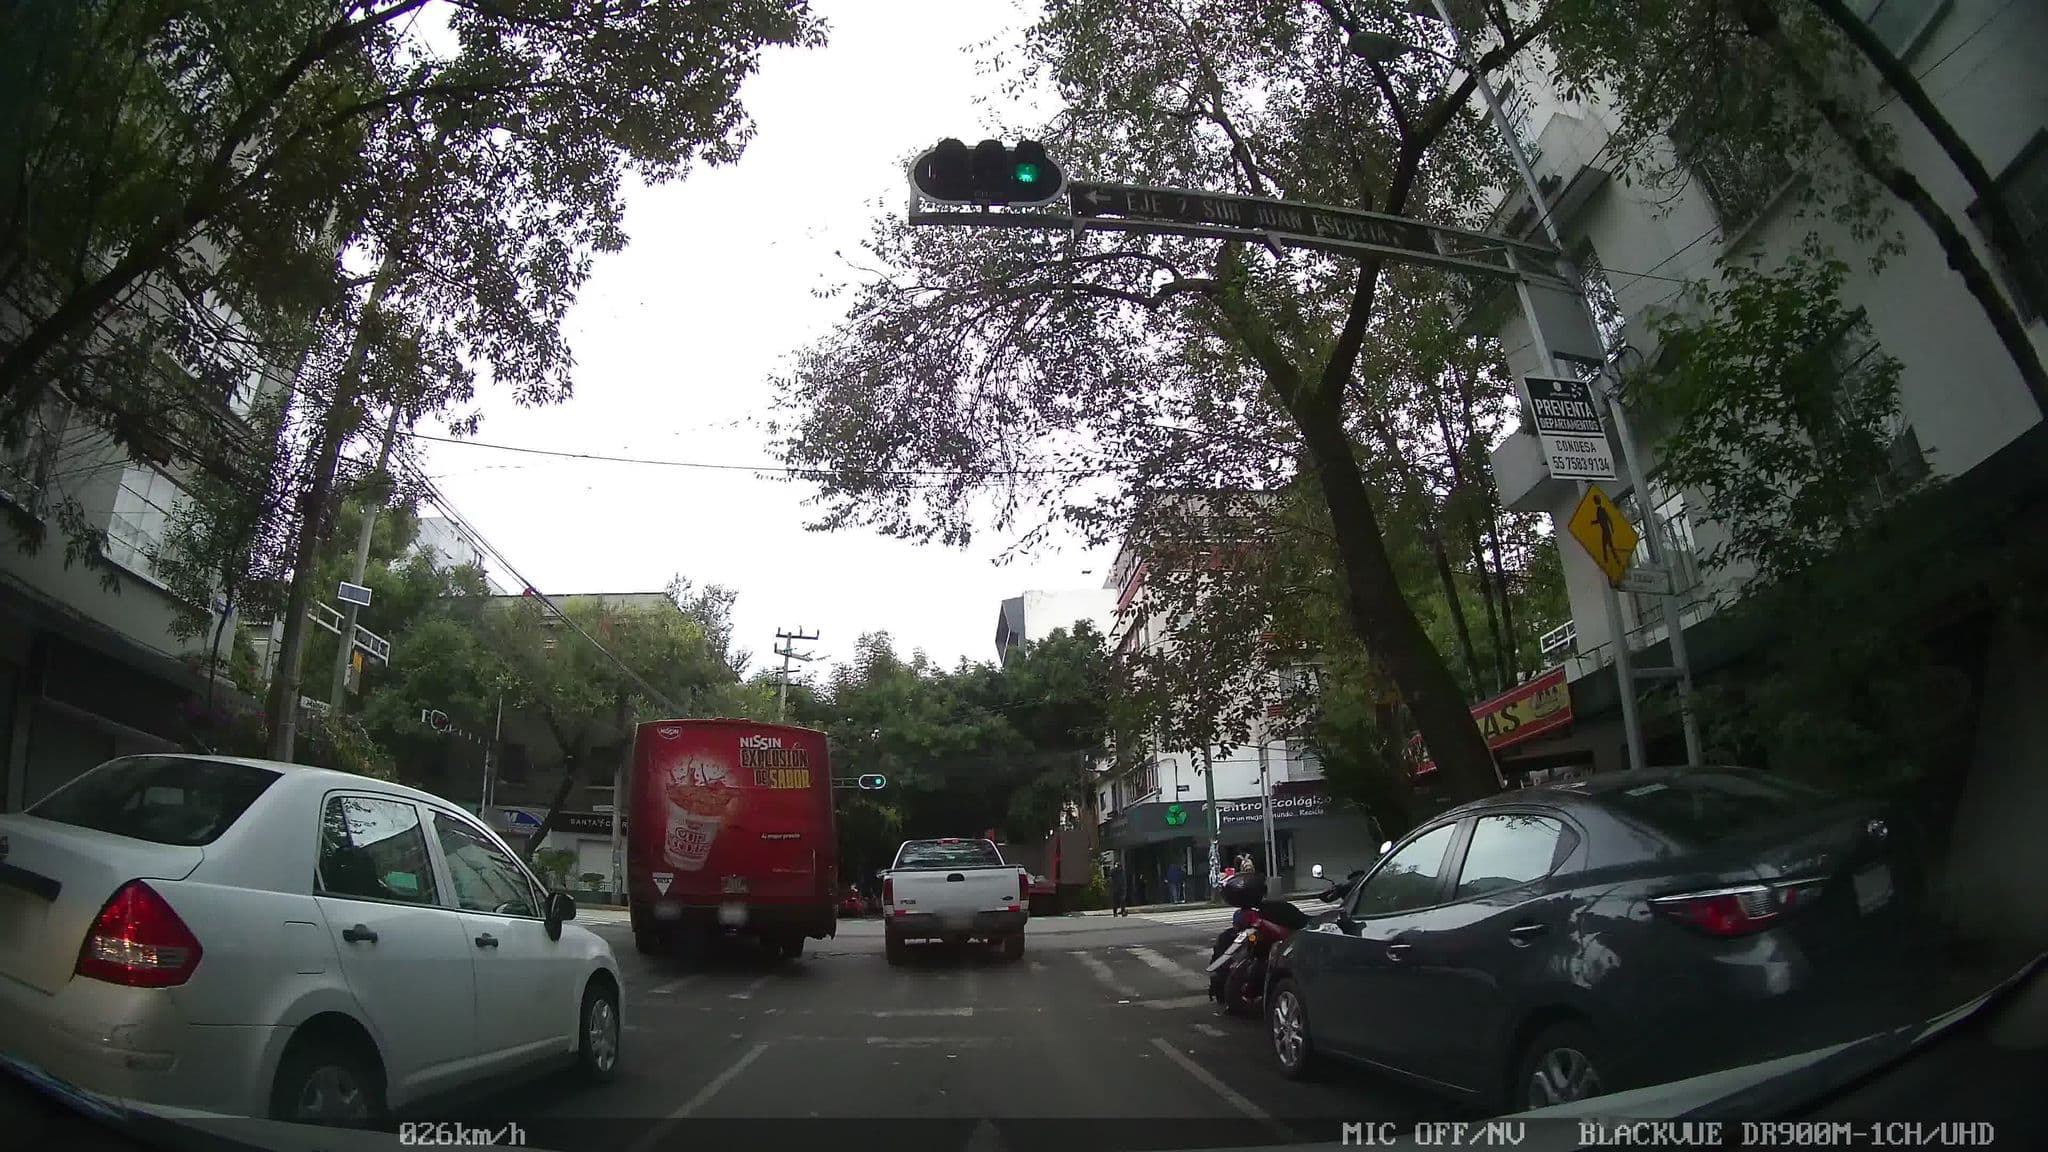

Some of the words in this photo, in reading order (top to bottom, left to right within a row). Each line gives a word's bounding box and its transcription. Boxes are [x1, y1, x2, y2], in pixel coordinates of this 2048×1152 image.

[1125, 191, 1162, 213] EJE
[1203, 199, 1241, 222] SUR
[1257, 203, 1302, 230] JUAN
[1535, 398, 1594, 418] PREVENTA
[1539, 417, 1599, 431] DEPARTAMENTOS
[1555, 439, 1597, 453] CONDESA
[1552, 456, 1565, 469] 55
[1565, 456, 1588, 470] 7583
[1588, 457, 1610, 471] 9134
[739, 734, 782, 750] NISSIN
